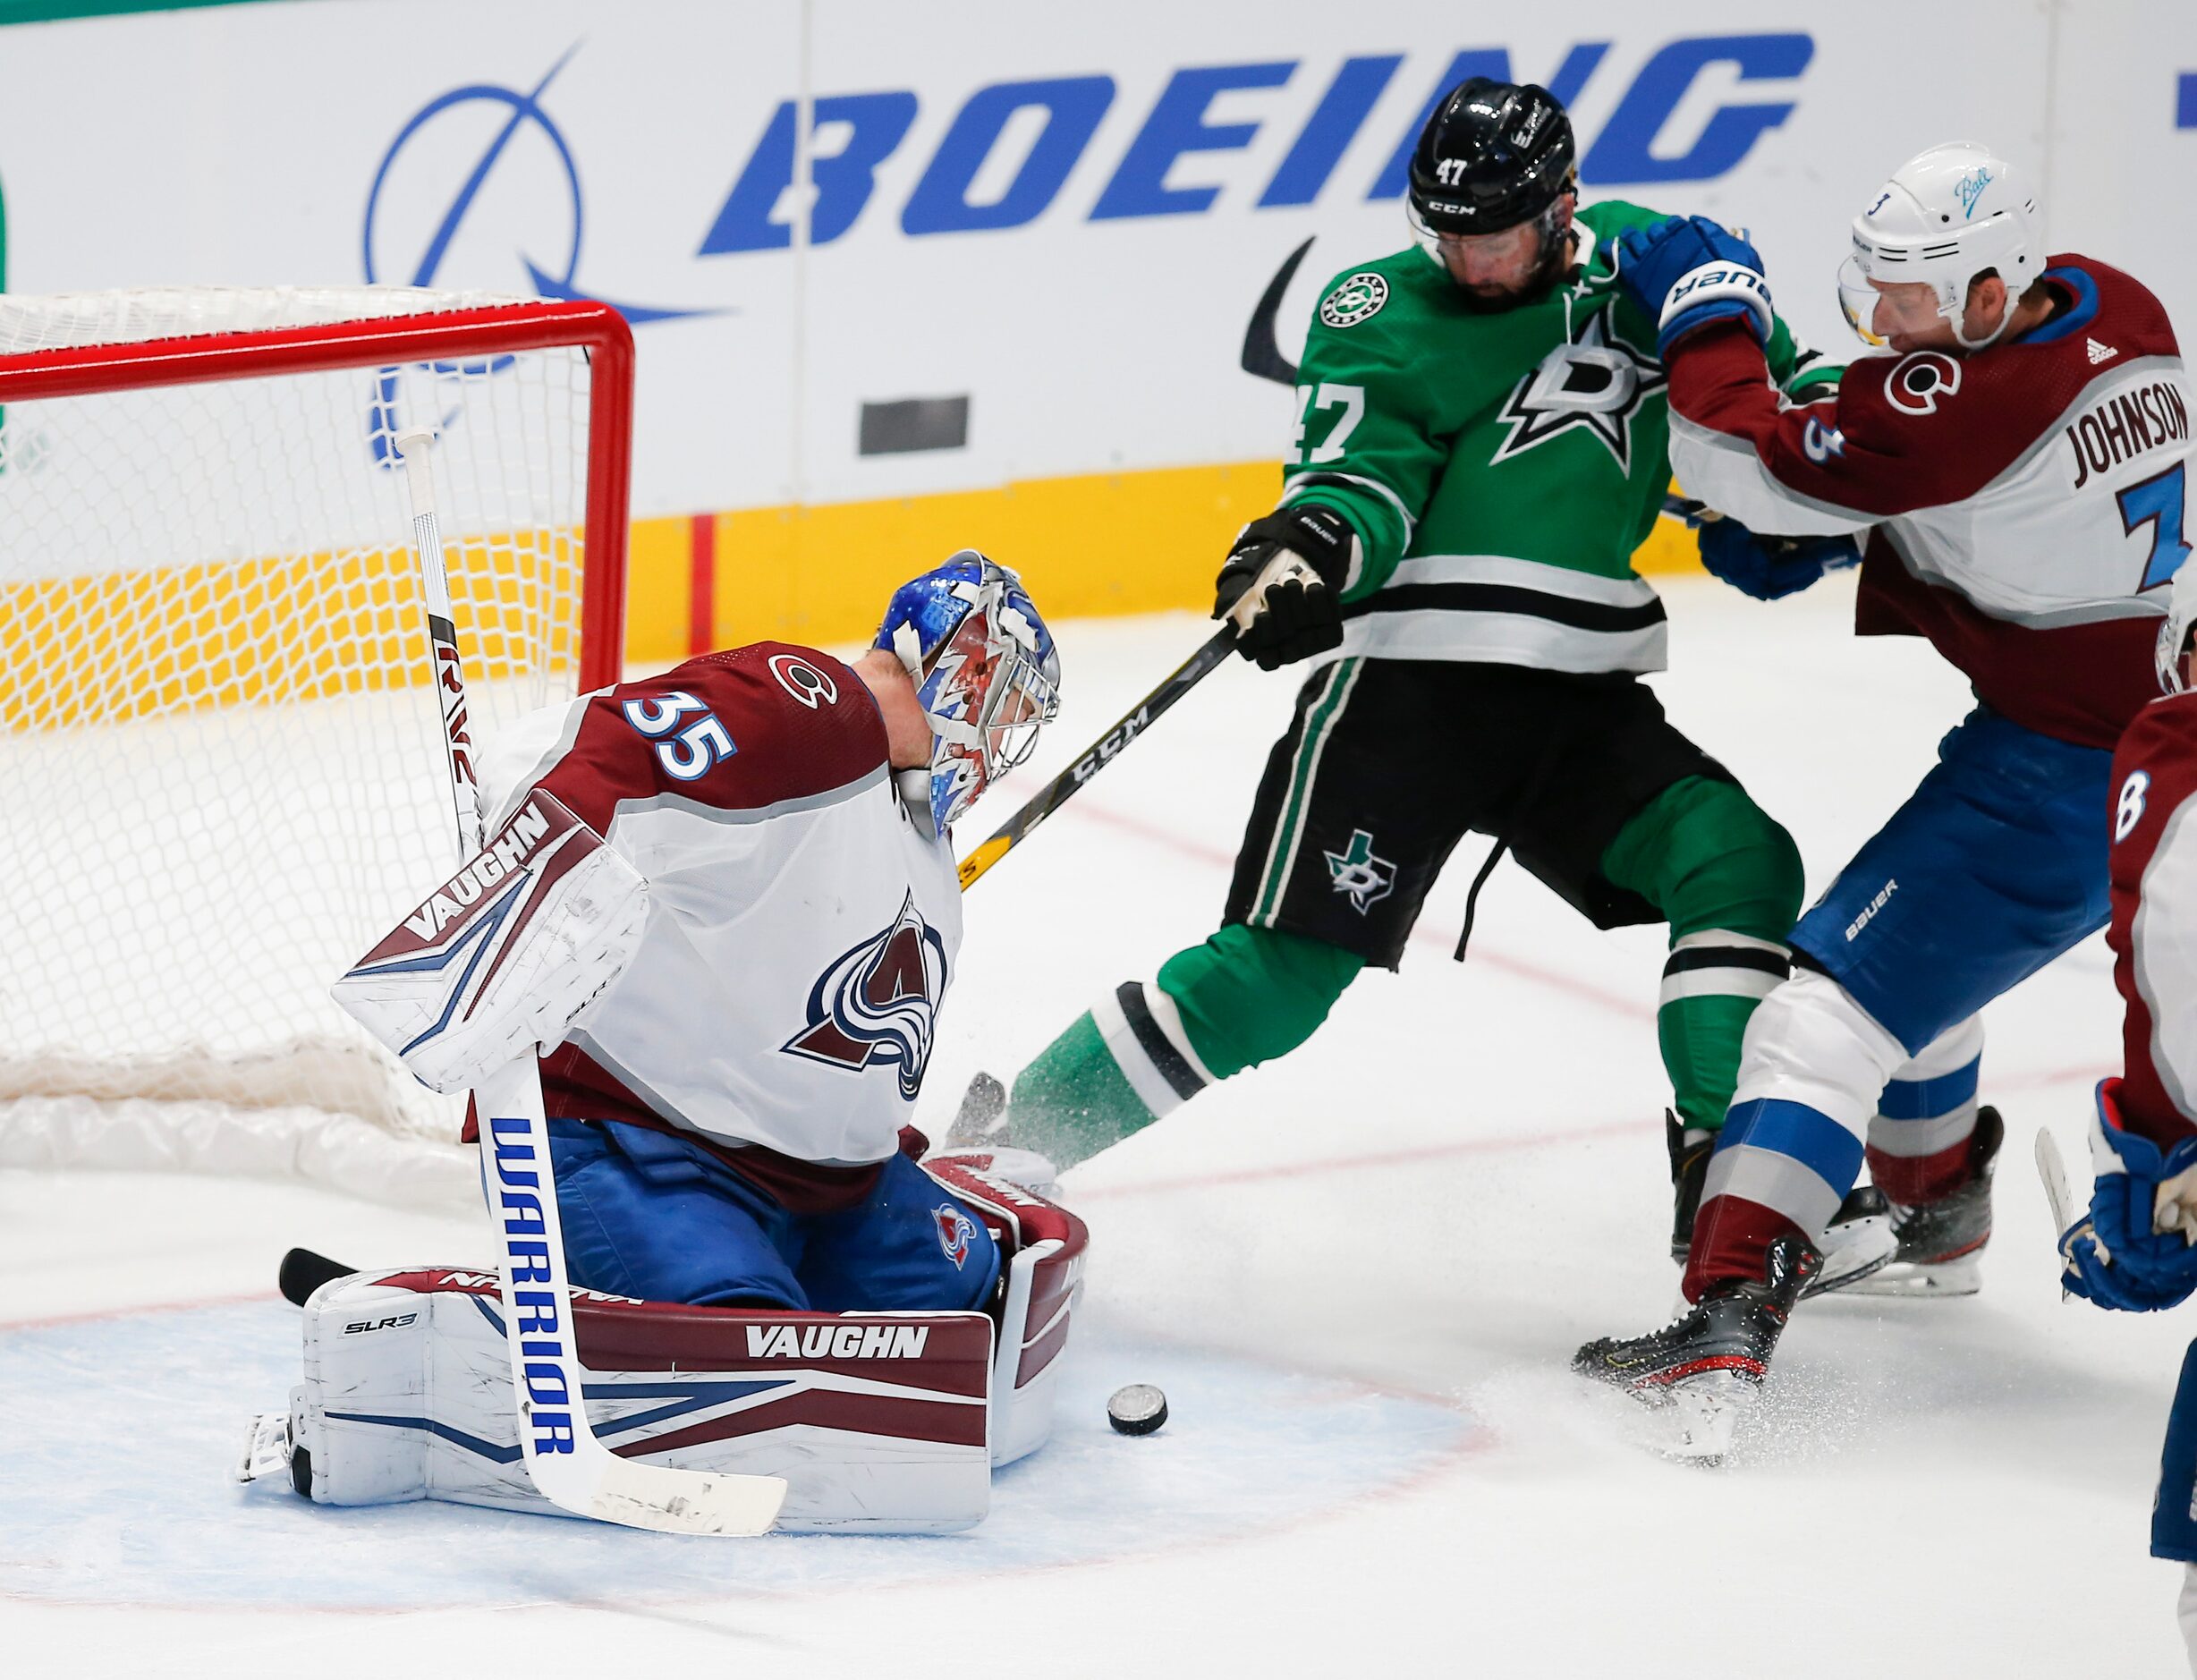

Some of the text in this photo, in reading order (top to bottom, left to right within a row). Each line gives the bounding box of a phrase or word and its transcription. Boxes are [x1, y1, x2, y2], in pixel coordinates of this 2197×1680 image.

[696, 32, 1815, 258] BOEING
[1436, 157, 1468, 186] 47
[1429, 200, 1476, 215] CCM
[1868, 193, 1890, 216] 3
[1955, 167, 1995, 220] Ball
[1804, 415, 1846, 464] 3
[2066, 383, 2188, 489] JOHNSON
[622, 691, 739, 781] 35
[1073, 705, 1149, 782] CCM
[403, 801, 551, 943] VAUGHN
[1845, 878, 1898, 942] BAUER
[490, 1118, 575, 1457] WARRIOR
[344, 1312, 418, 1335] SLR3
[745, 1325, 929, 1359] VAUGHN
